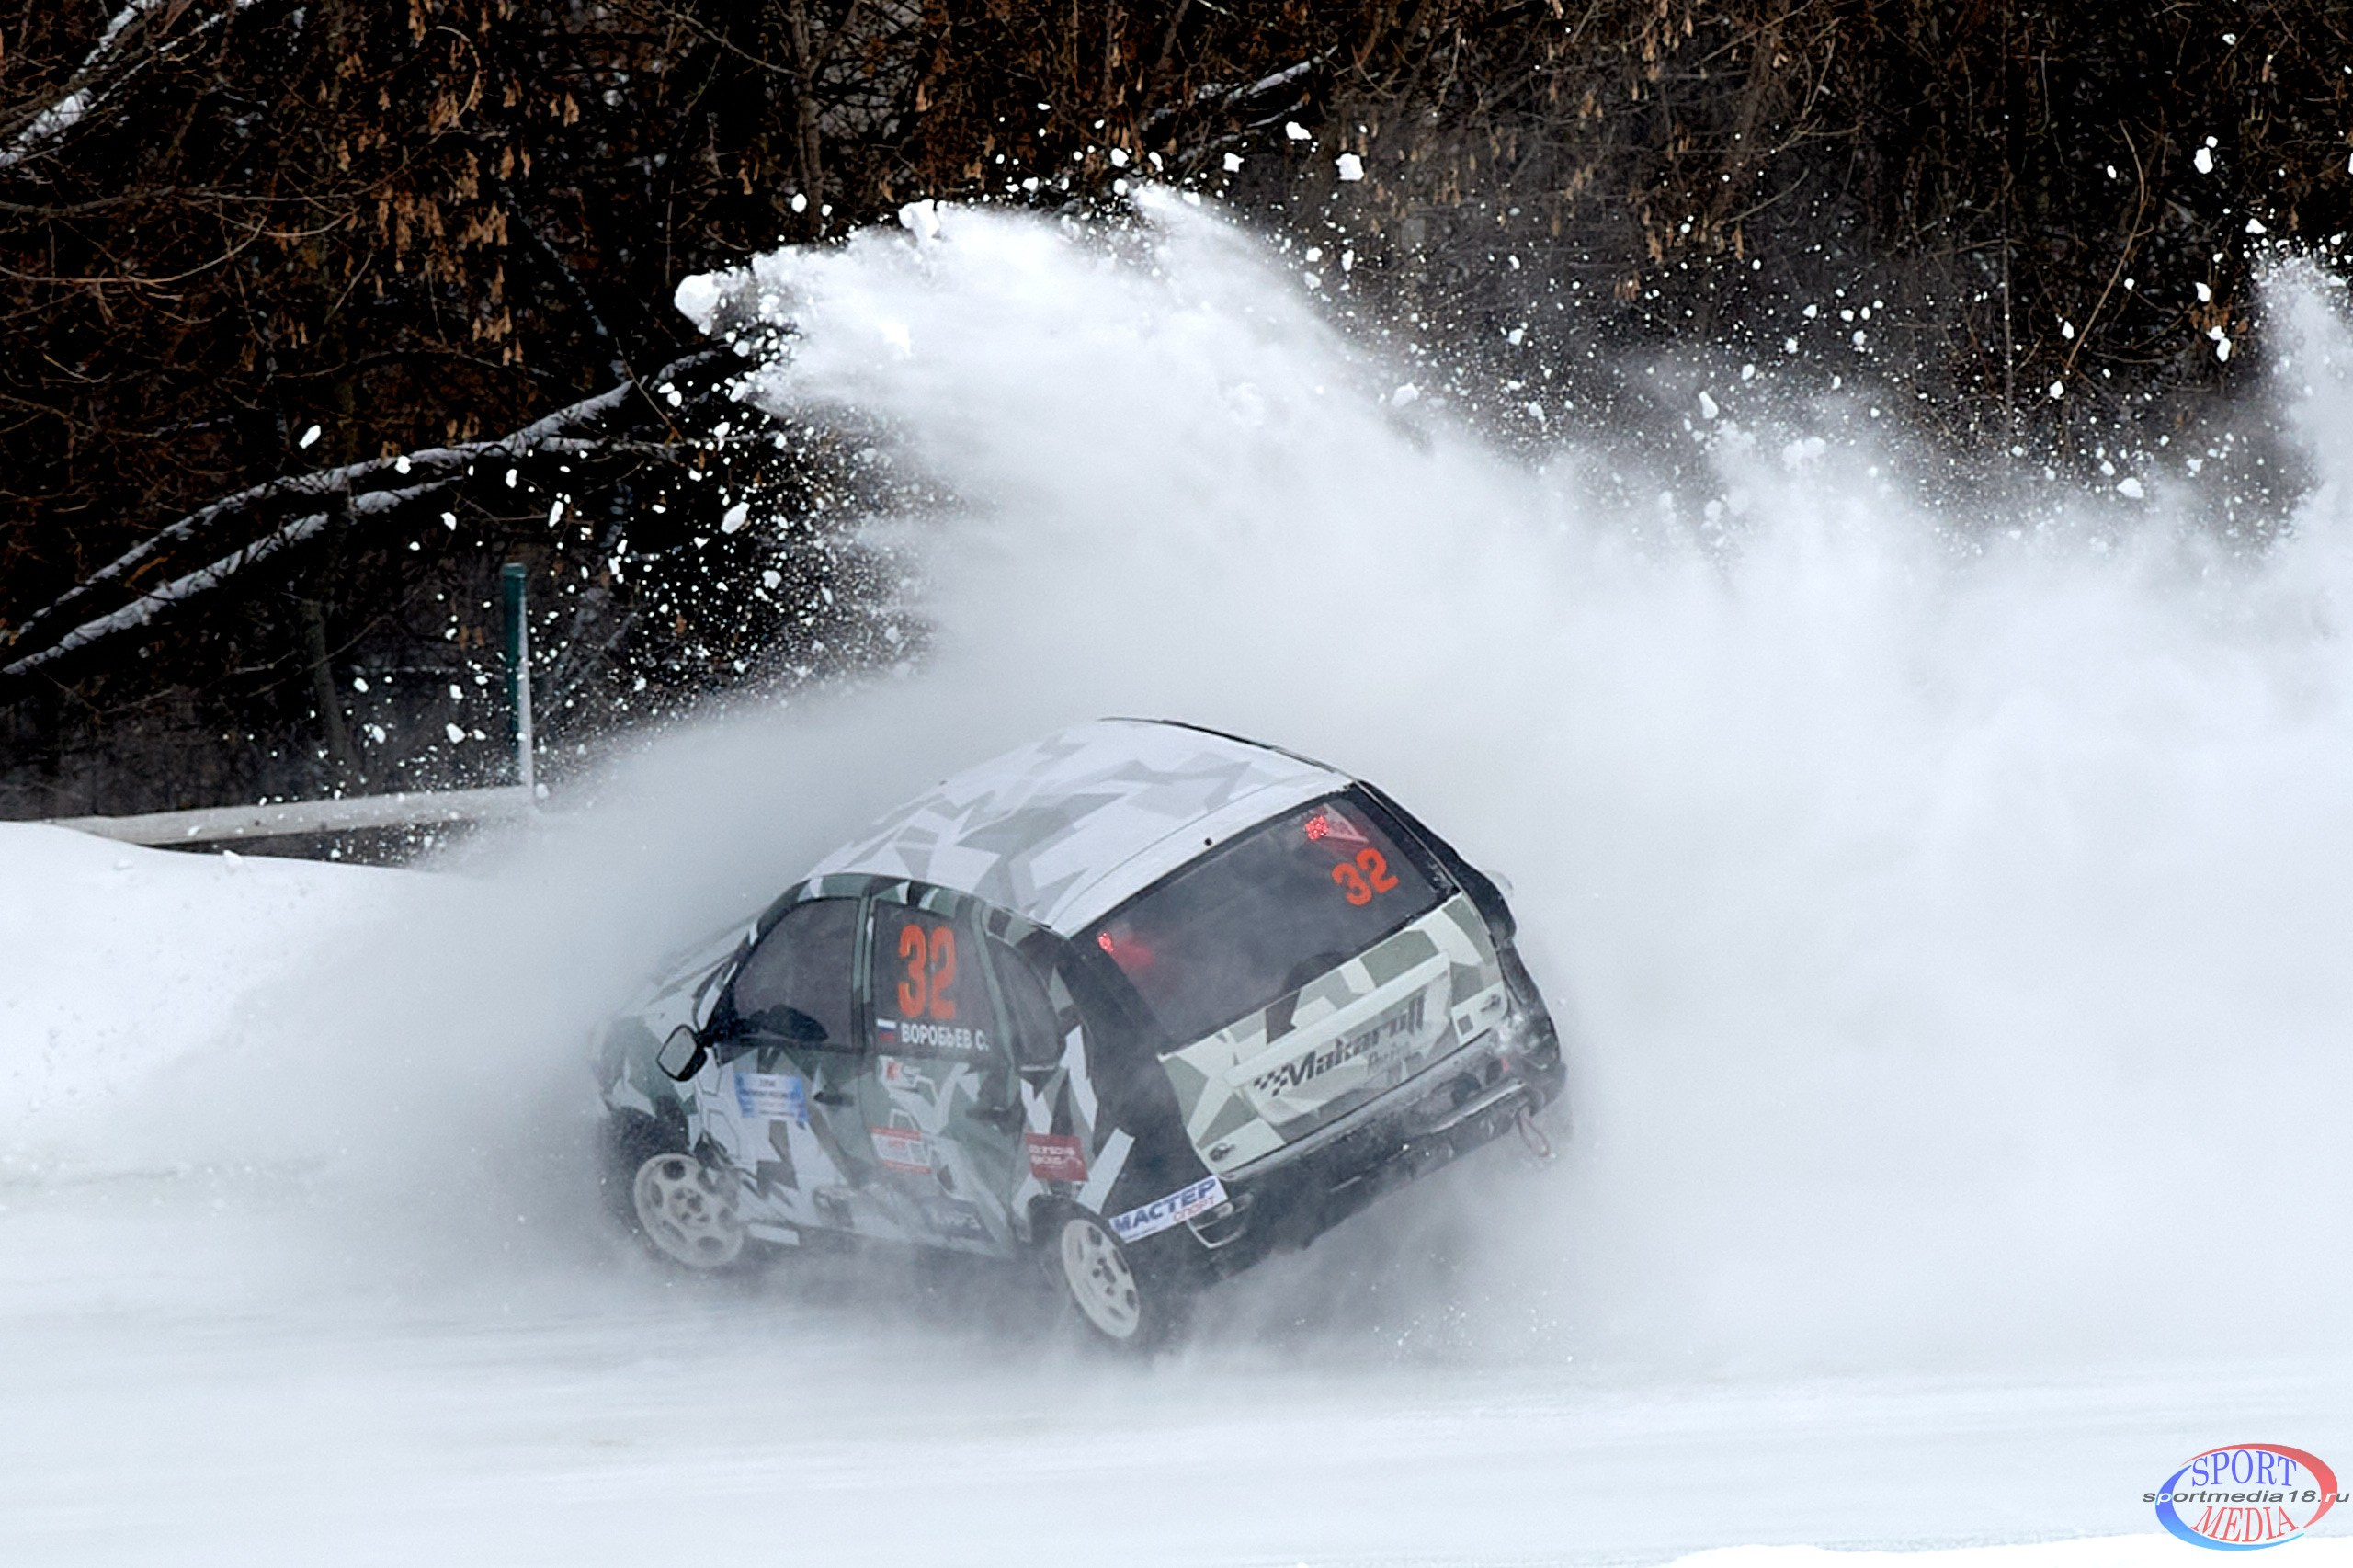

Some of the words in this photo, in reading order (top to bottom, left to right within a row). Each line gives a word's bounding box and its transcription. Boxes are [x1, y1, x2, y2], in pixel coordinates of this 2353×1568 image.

[1332, 847, 1399, 906] 32
[898, 924, 957, 1019] 32
[900, 1022, 972, 1050] ВОРОБЬЕВ
[1113, 1178, 1216, 1234] МАСТЕР
